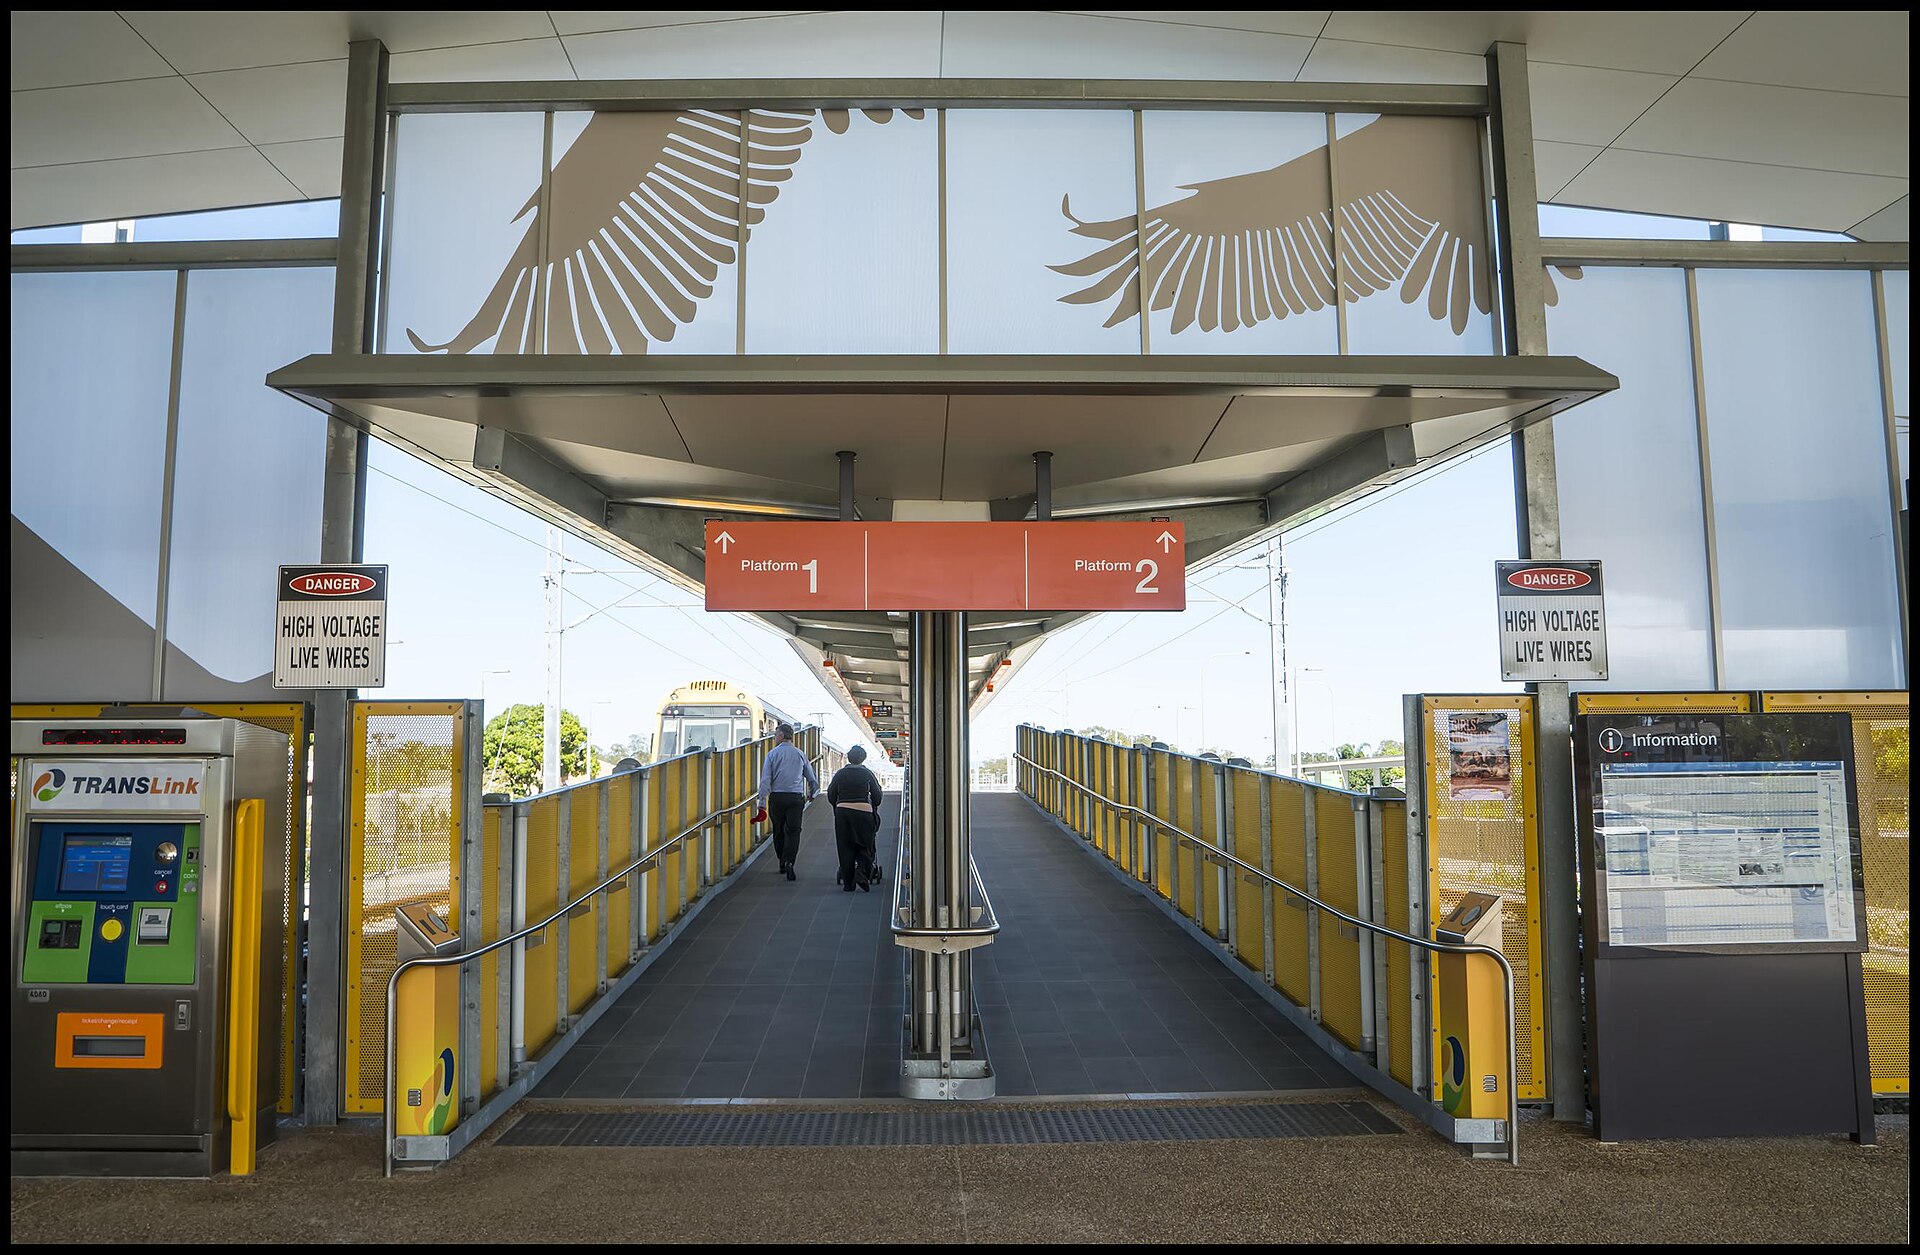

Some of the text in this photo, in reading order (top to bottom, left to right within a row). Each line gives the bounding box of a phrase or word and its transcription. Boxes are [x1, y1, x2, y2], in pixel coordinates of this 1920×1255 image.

[305, 578, 360, 590] DANGER
[741, 559, 818, 594] Platform 1
[1075, 558, 1159, 594] Platform 2
[1523, 574, 1576, 585] DANGER
[282, 616, 380, 637] HIGH VOLTAGE
[1505, 610, 1600, 632] HIGH VOLTAGE
[290, 647, 370, 668] LIVE WIRES
[1515, 640, 1592, 662] LIVE WIRES
[1632, 733, 1717, 747] Information
[72, 777, 200, 794] TRANSLink
